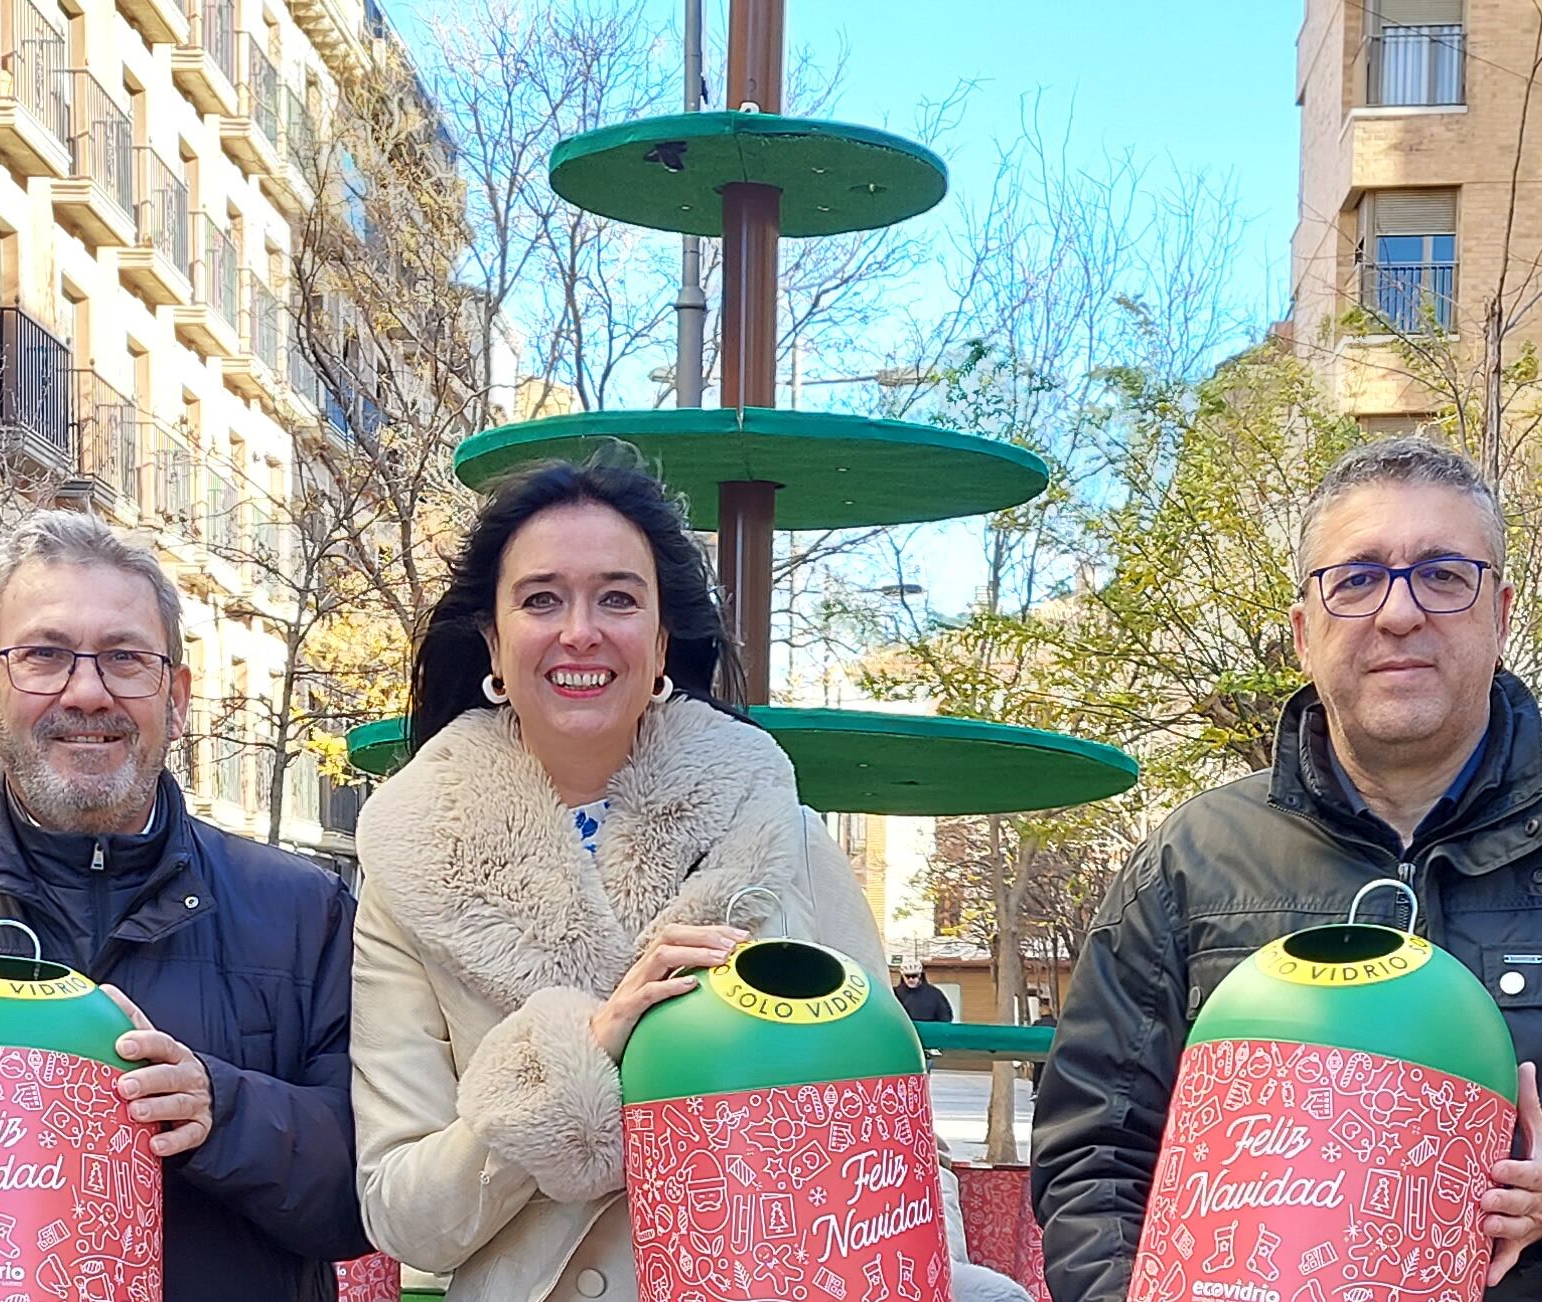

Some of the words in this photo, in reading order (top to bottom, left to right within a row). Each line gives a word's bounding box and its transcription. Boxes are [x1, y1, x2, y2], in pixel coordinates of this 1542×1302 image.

[10, 977, 87, 996] VIDRIO
[1312, 956, 1408, 982] VIDRIO
[726, 985, 793, 1018] SOLO
[806, 974, 866, 1018] VIDRIO
[1220, 1113, 1312, 1166] Feliz
[841, 1149, 908, 1205] Feliz
[1180, 1167, 1346, 1220] Navidad
[812, 1186, 933, 1263] Navidad
